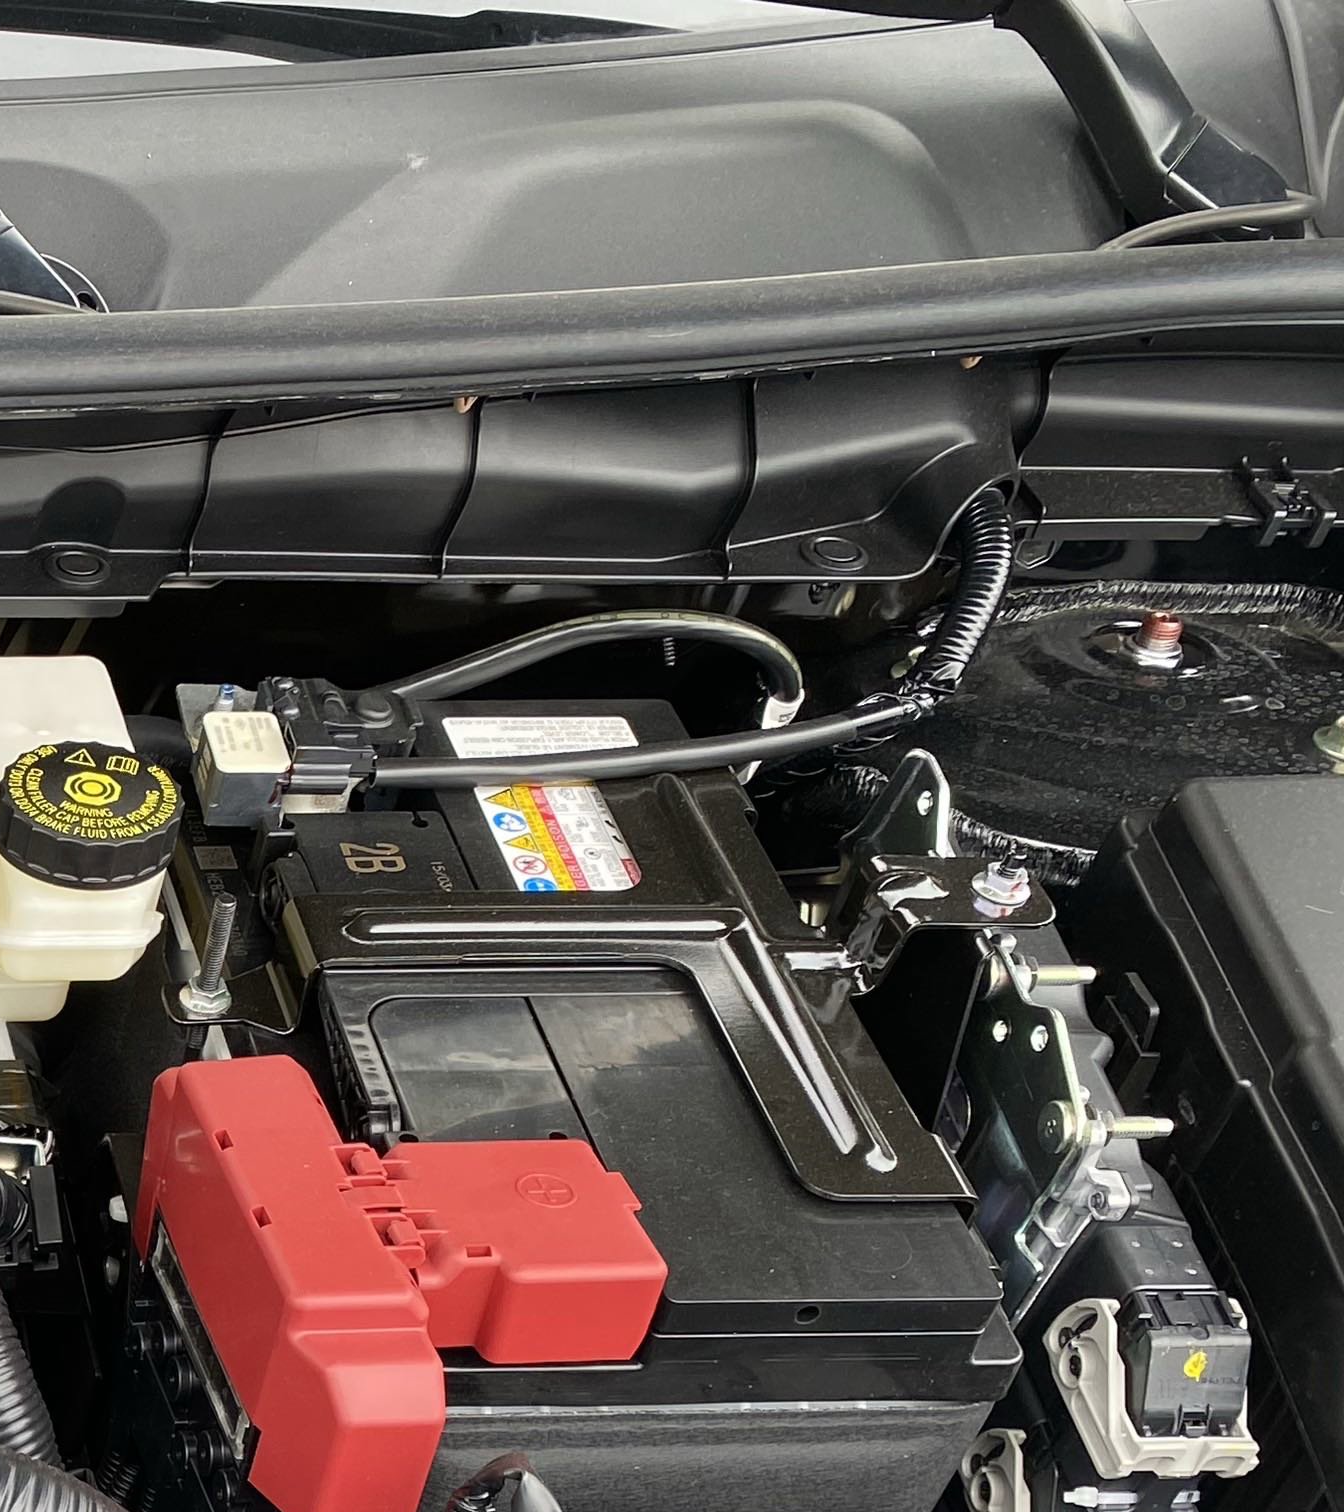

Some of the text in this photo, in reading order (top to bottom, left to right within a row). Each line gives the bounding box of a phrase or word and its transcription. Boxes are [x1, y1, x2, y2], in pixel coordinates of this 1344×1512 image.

[36, 745, 58, 757] USE
[16, 754, 39, 771] ONLY
[26, 768, 44, 791] CLEAN
[9, 786, 24, 799] OR
[28, 790, 58, 815] FILLER
[59, 800, 113, 818] WARNING
[34, 813, 71, 833] BRAKE
[55, 809, 80, 823] CAP
[81, 816, 129, 828] BEFORE
[73, 826, 108, 839] FLUID
[111, 826, 145, 839] FROM
[140, 820, 153, 832] A
[339, 842, 407, 873] 2B
